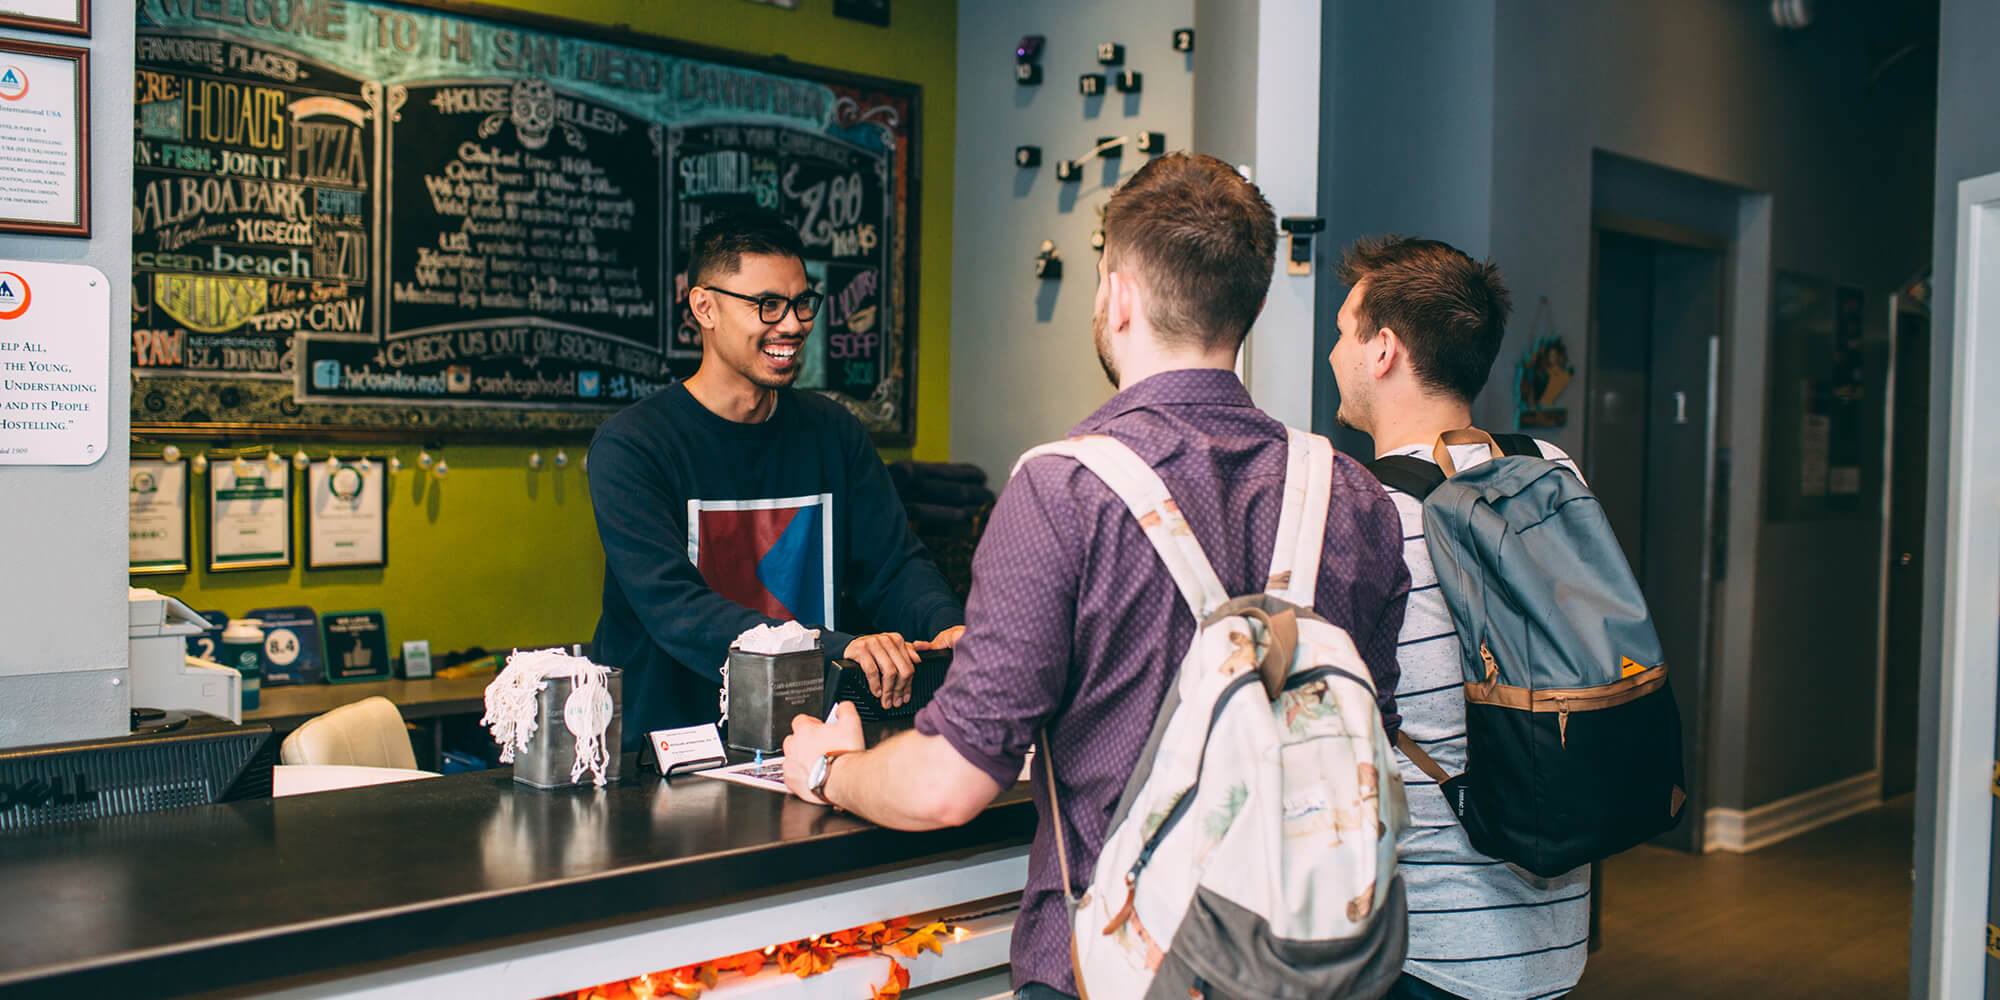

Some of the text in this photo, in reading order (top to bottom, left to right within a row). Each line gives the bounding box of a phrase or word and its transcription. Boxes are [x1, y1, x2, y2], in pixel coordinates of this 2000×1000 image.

[373, 9, 418, 51] TO
[440, 19, 472, 63] HI
[494, 29, 559, 76] SAN
[576, 42, 665, 92] DIEGO
[1178, 32, 1190, 48] 2
[136, 37, 299, 83] FAVORITE PLACES
[440, 87, 618, 133] HOUSE RULES
[161, 144, 211, 170] FISH
[215, 150, 288, 180] JOINT
[287, 120, 369, 188] PIZZA
[241, 181, 314, 222] PARK
[236, 217, 315, 247] MUSEUM
[212, 244, 311, 280] beach
[249, 297, 365, 332] TIPSY CROW
[188, 336, 277, 348] NEIGHBORHOOD
[386, 334, 456, 369] CHECK
[458, 331, 487, 356] US
[490, 328, 530, 353] OUT
[533, 330, 557, 353] ON
[560, 333, 613, 366] SOCIAL
[830, 333, 880, 359] SOAP
[4, 360, 72, 374] THE YOUNG,
[188, 349, 279, 371] EL DORADO
[5, 380, 97, 393] UNDERSTANDING
[5, 400, 91, 412] AND ITS PEOPLE
[1673, 389, 1688, 424] 1
[269, 635, 295, 655] 8.4
